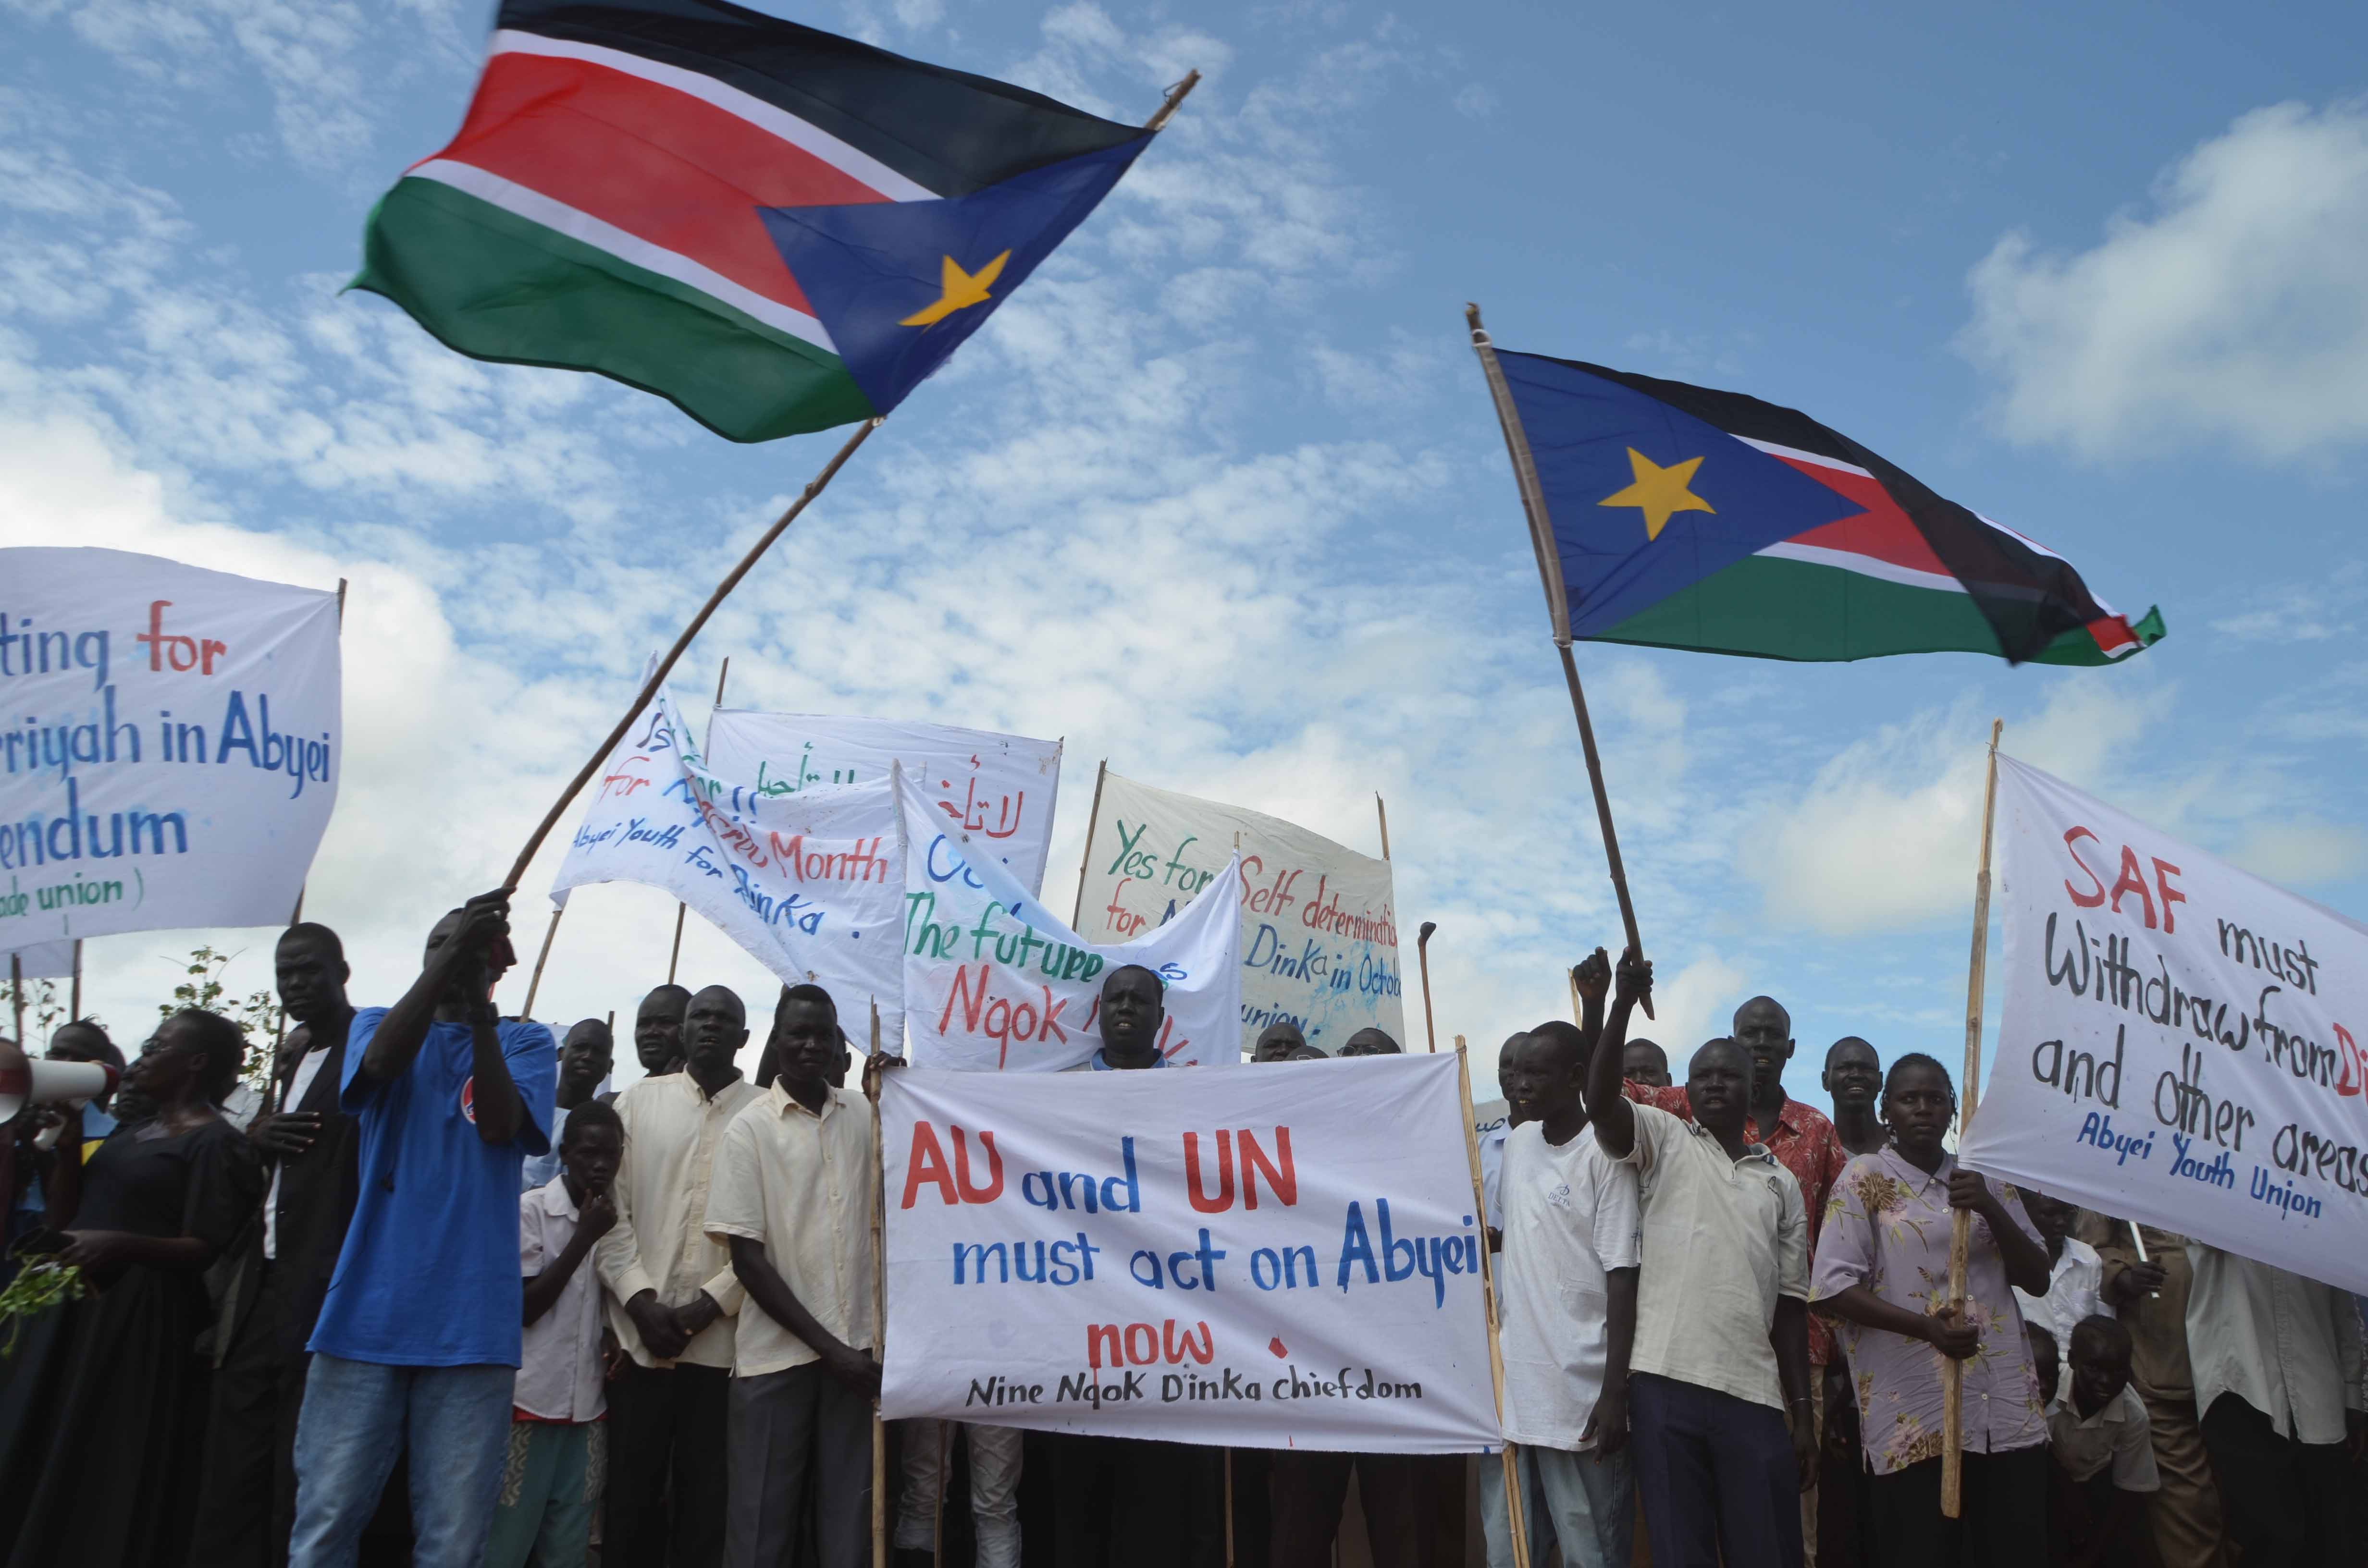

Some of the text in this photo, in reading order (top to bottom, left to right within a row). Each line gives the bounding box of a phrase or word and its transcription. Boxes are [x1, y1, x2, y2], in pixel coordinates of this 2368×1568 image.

[136, 600, 227, 675] for
[0, 684, 330, 800] riyah in Abyei
[614, 818, 686, 850] Youth
[685, 845, 723, 879] for
[770, 831, 888, 883] Month
[1108, 820, 1158, 879] Yes
[1163, 837, 1214, 895] for
[1240, 855, 1304, 916] Self
[902, 892, 961, 960] The
[1106, 877, 1146, 937] for
[1330, 954, 1352, 991] in
[2063, 825, 2319, 995] SAF must
[2253, 985, 2337, 1090] from
[2032, 1024, 2126, 1110] and
[2154, 1042, 2255, 1156] other
[901, 1121, 1297, 1213] AU and UN
[2076, 1112, 2322, 1219] Abyei Youth Union
[953, 1198, 1479, 1309] must act on Abyei
[965, 1375, 1044, 1408] Nine
[1272, 1364, 1422, 1400] chiefdom
[1087, 1319, 1214, 1368] now
